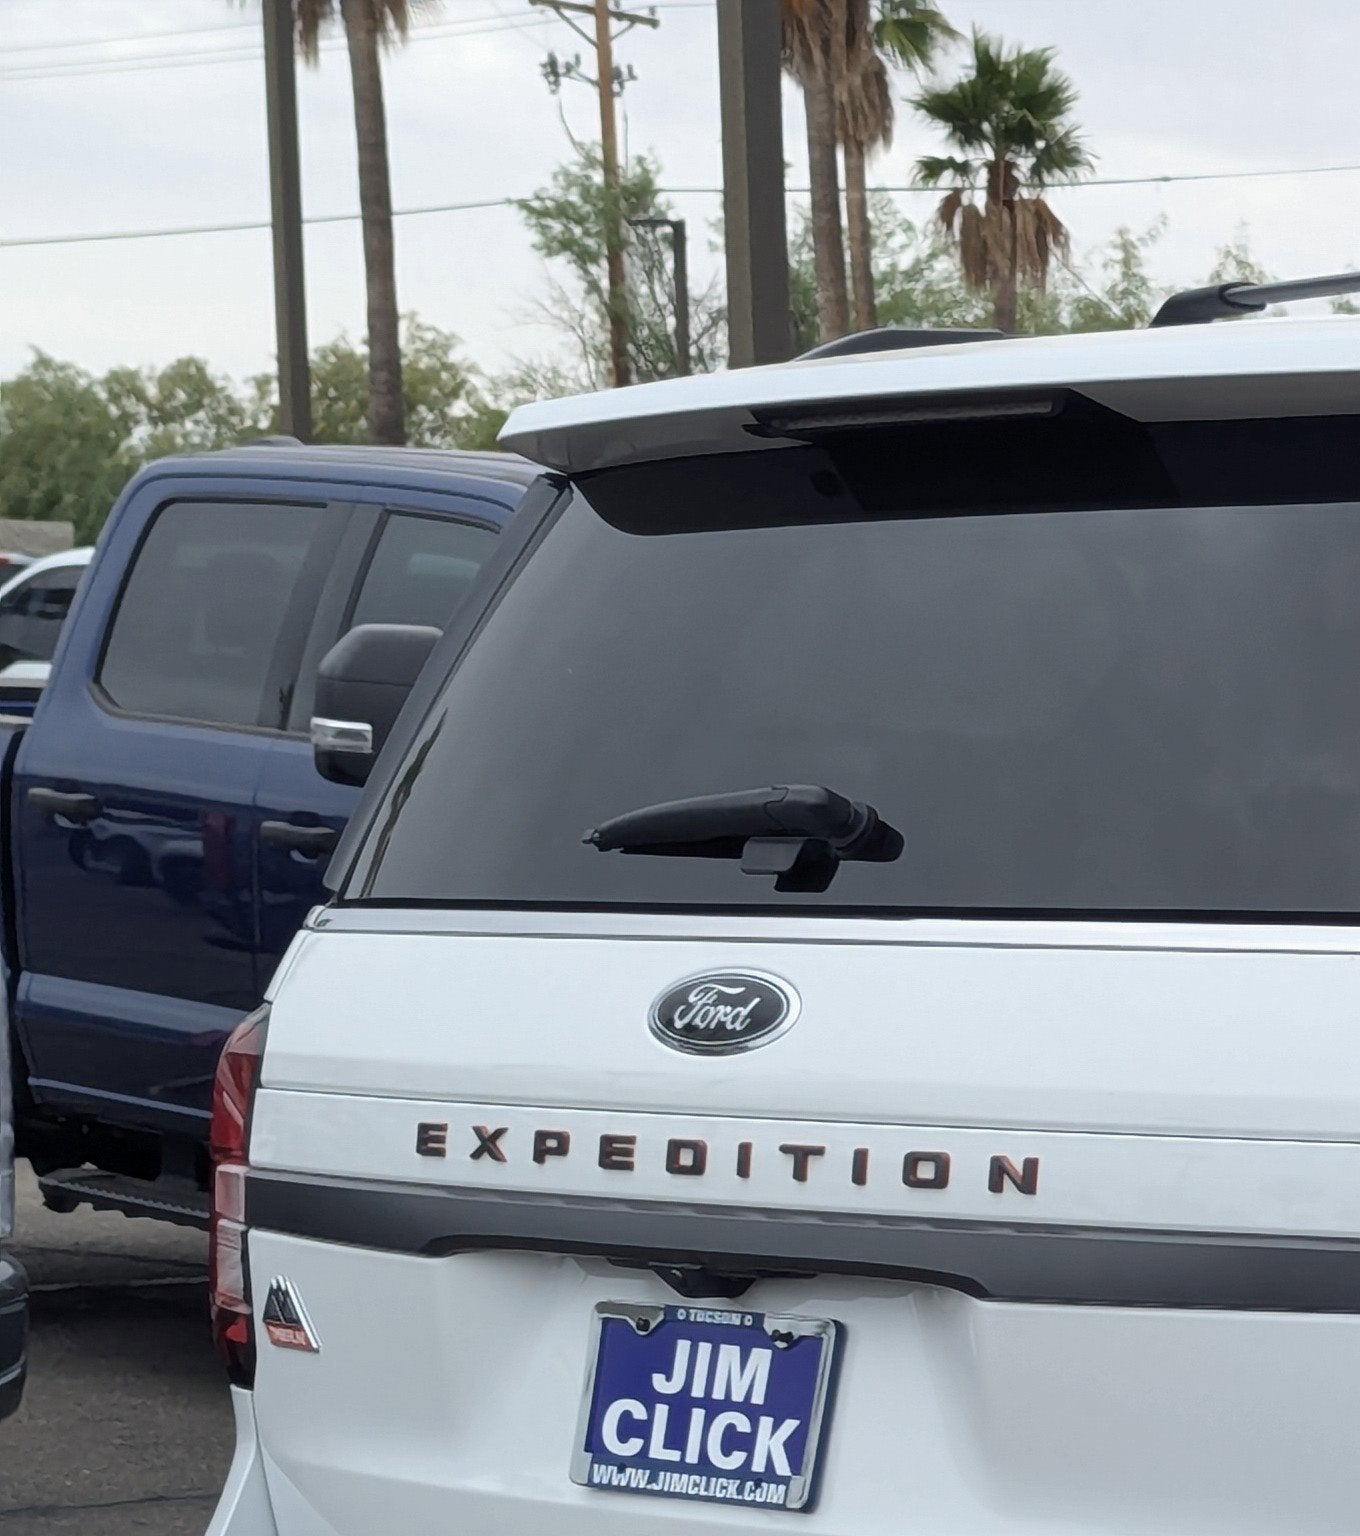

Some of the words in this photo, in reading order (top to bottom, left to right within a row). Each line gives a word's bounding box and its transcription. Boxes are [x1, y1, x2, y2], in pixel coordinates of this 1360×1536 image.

[673, 983, 761, 1031] Ford
[415, 1121, 1040, 1196] EXPEDITION
[651, 1338, 773, 1406] JIM
[601, 1398, 801, 1477] CLICK
[592, 1463, 788, 1505] WWW.JIMCLICK.COM
